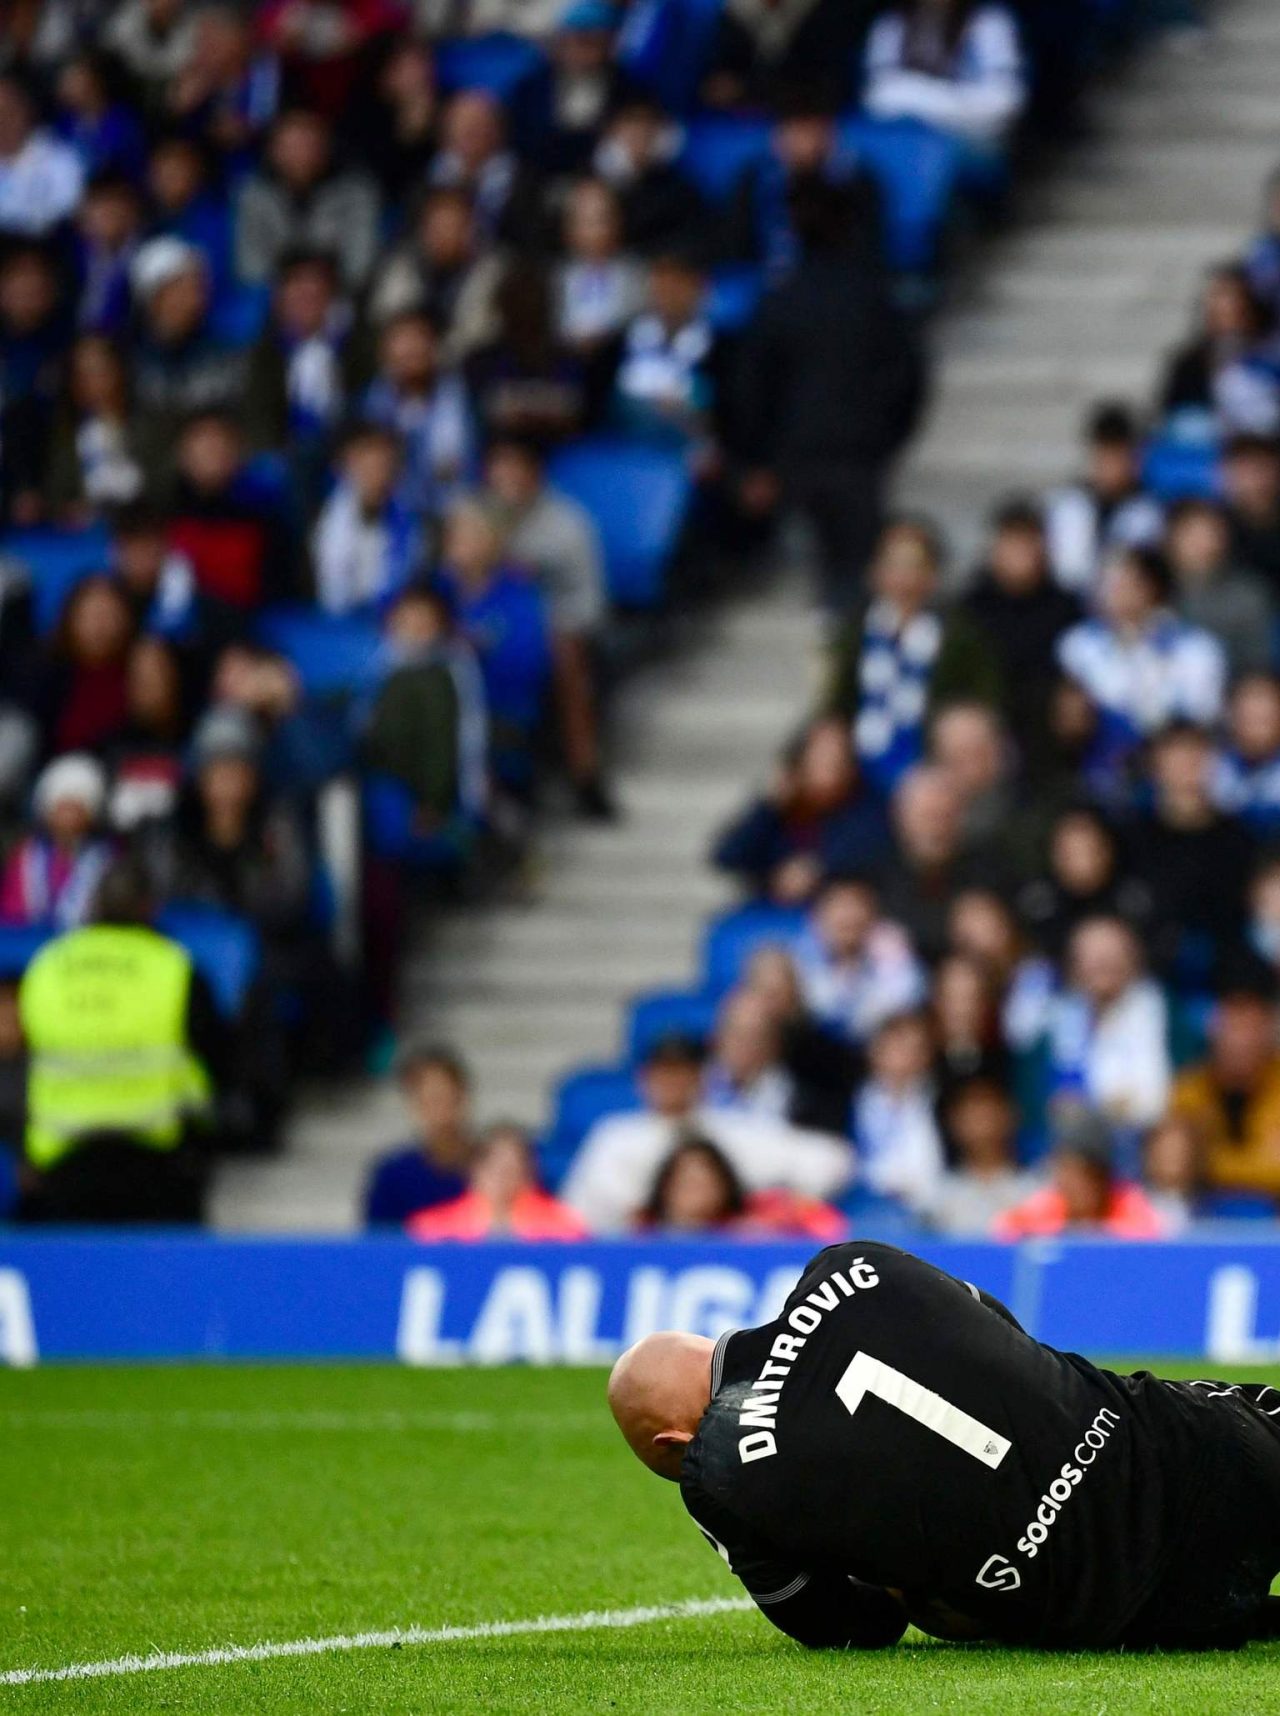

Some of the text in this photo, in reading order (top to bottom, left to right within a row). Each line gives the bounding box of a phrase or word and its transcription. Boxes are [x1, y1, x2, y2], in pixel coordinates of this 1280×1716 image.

[398, 1265, 805, 1368] LALIG
[738, 1256, 880, 1464] DMITROVIĆ
[834, 1350, 1013, 1470] 1
[1017, 1407, 1121, 1558] socios.com
